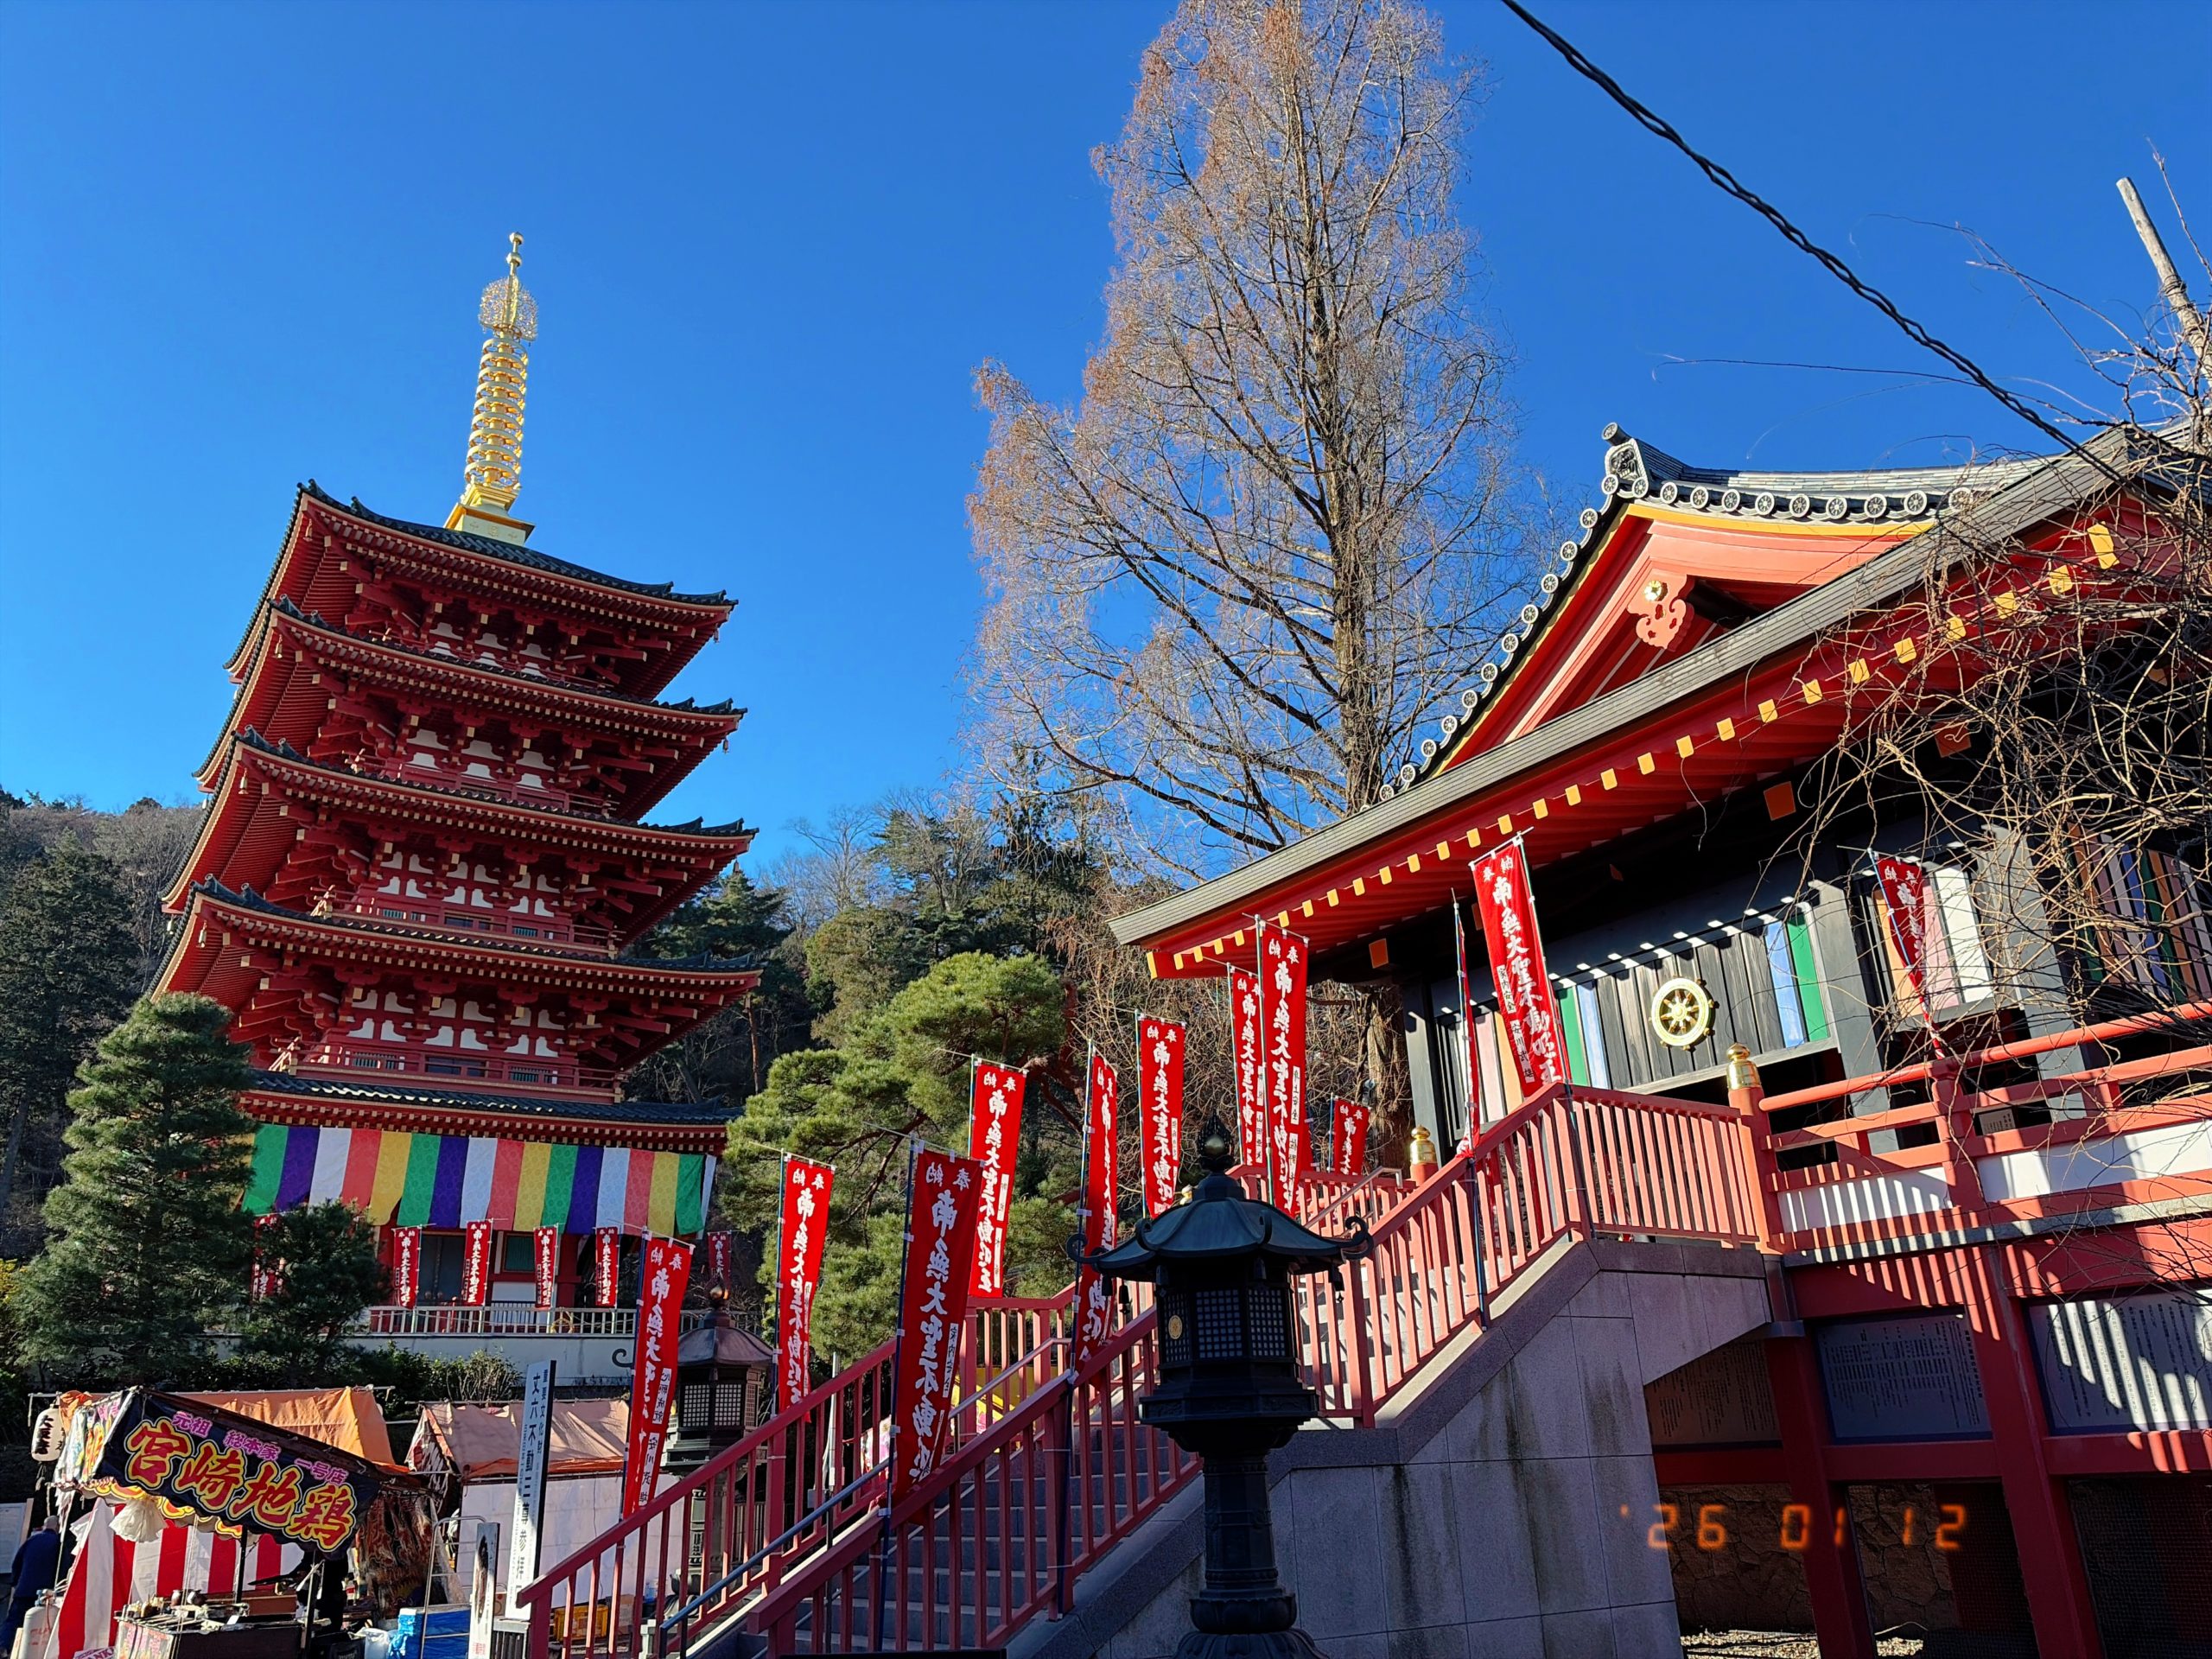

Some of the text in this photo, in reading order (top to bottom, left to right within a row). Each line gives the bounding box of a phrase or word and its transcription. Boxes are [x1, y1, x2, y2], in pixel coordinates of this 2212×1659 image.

[125, 1418, 356, 1551] 宮崎地鶏
[172, 1411, 350, 1486] 元祖 総本家 一号店
